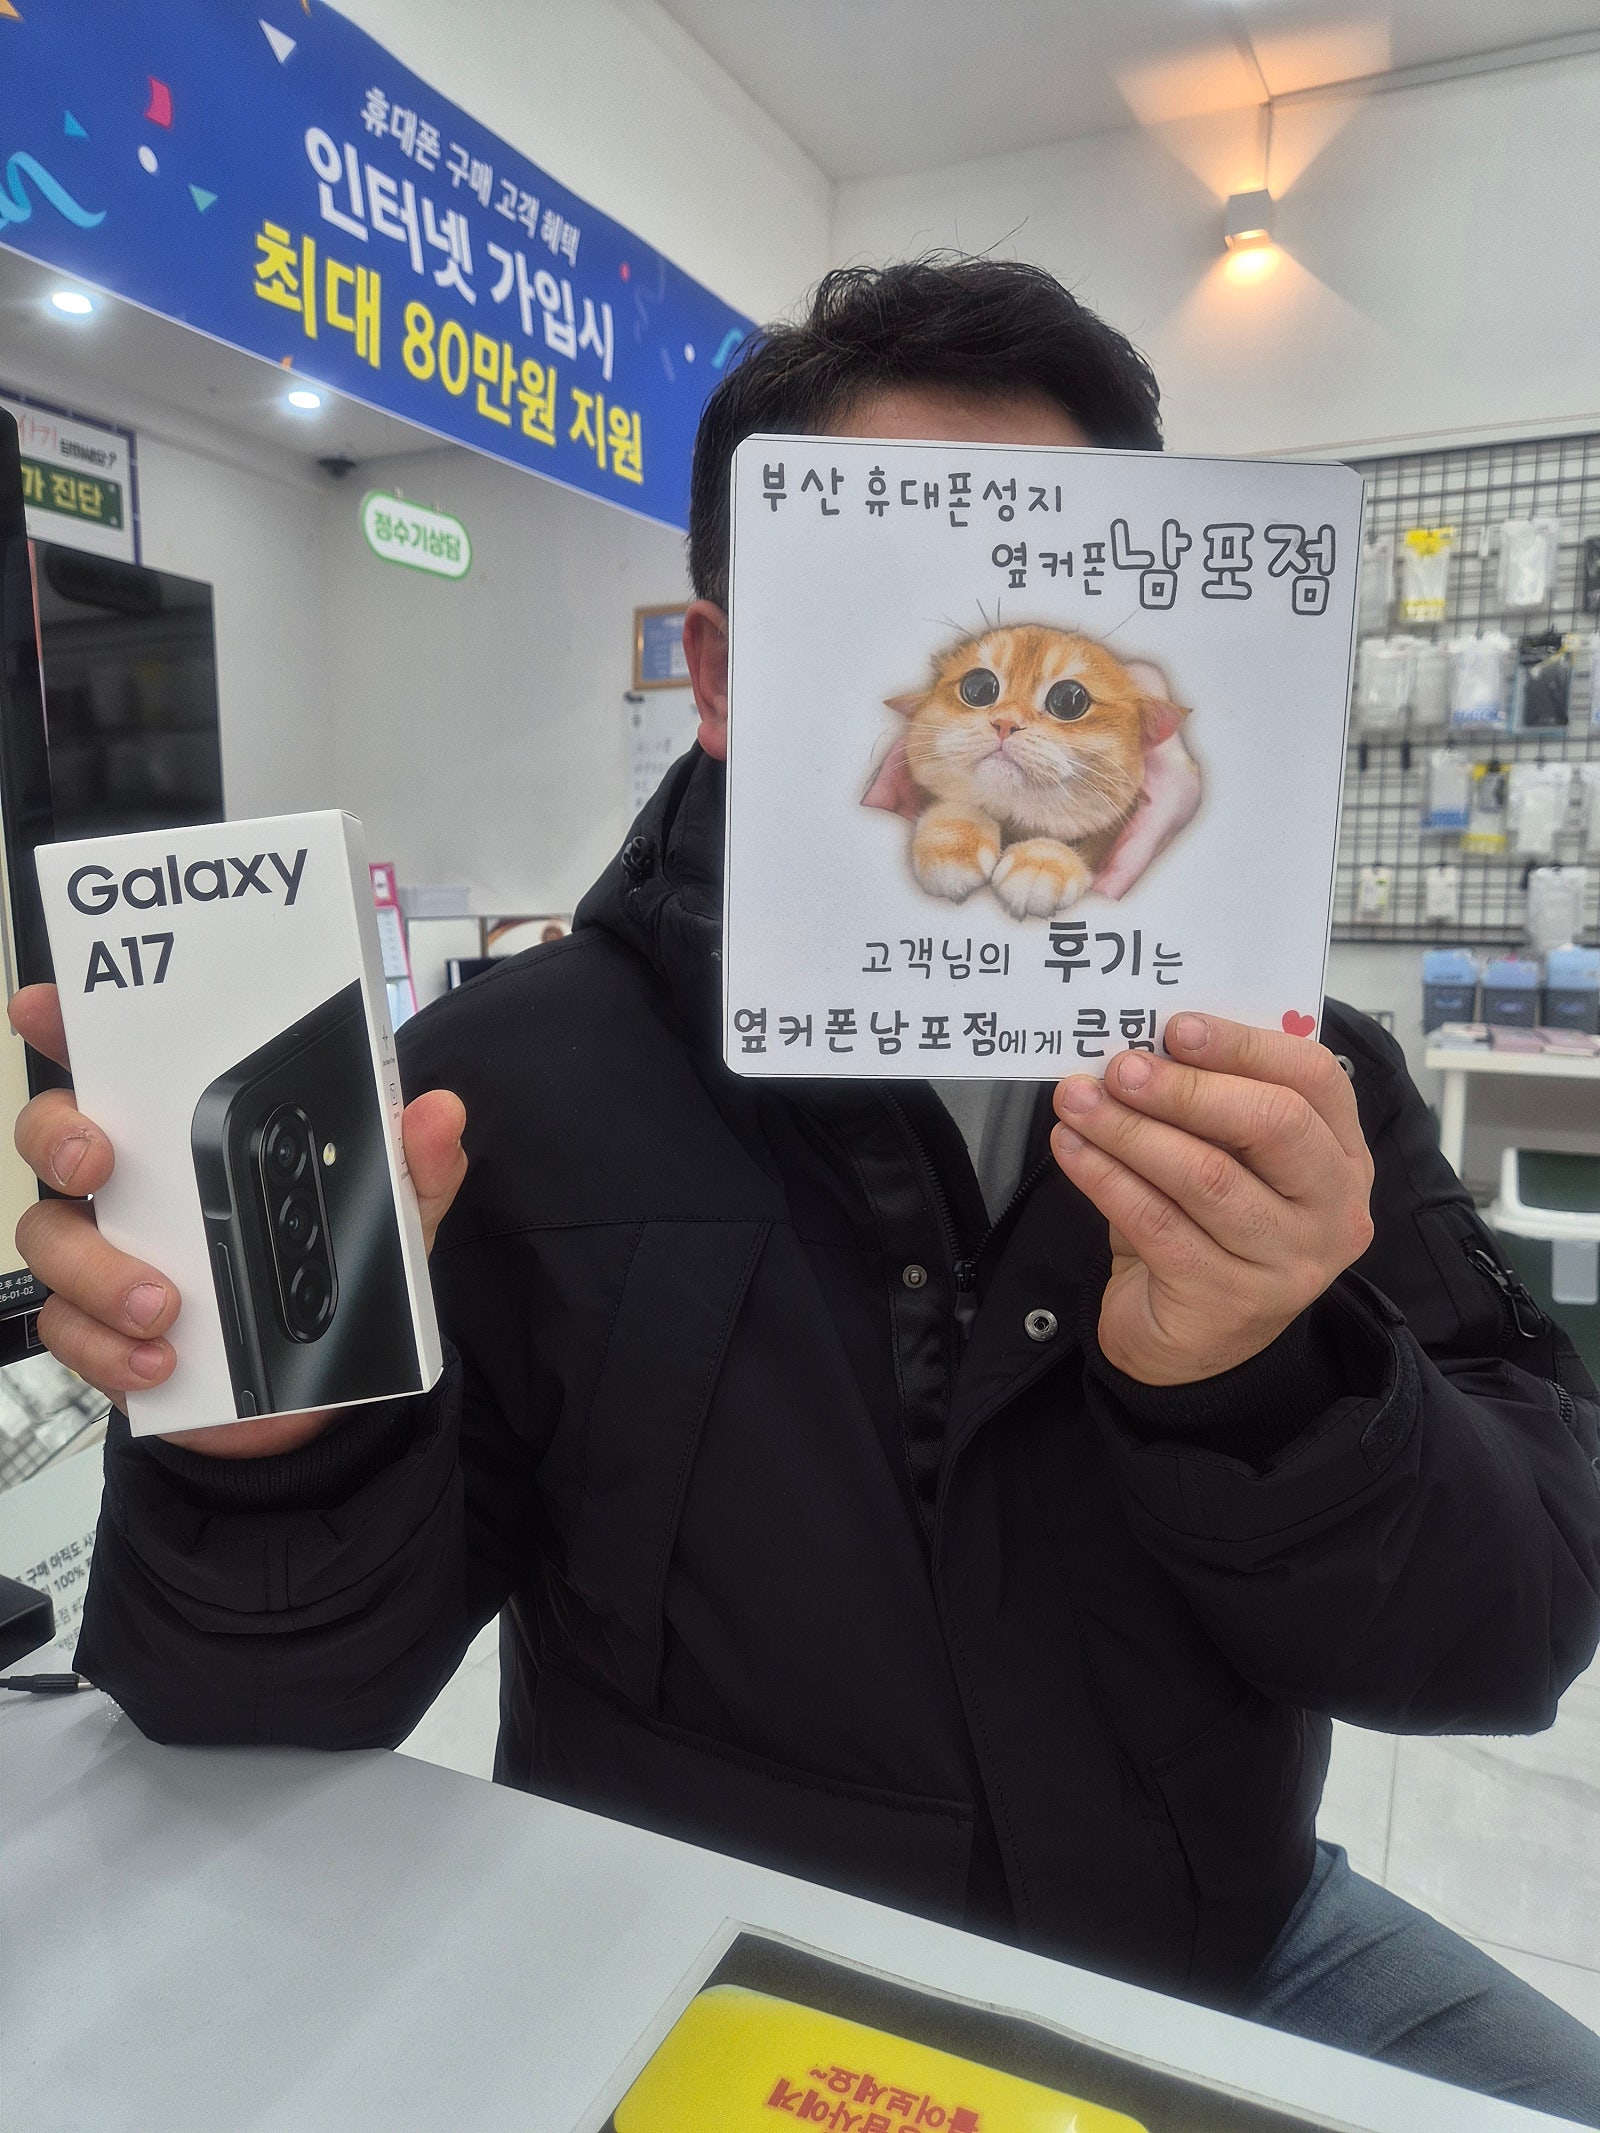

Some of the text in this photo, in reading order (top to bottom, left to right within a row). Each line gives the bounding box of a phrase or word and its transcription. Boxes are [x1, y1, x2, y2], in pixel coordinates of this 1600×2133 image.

[360, 86, 581, 267] 휴대폰 구매 고객 혜택
[305, 126, 614, 382] 인터넷 가입시
[254, 220, 643, 485] 최대 80만원 지원
[51, 473, 104, 518] 진단
[763, 462, 844, 516] 부산
[375, 510, 461, 562] 정수기상담
[67, 848, 308, 915] Galaxy
[84, 931, 174, 993] A17
[861, 920, 1183, 986] 고객님의 후기는
[26, 1560, 50, 1584] 구매
[54, 1564, 85, 1592] 100%
